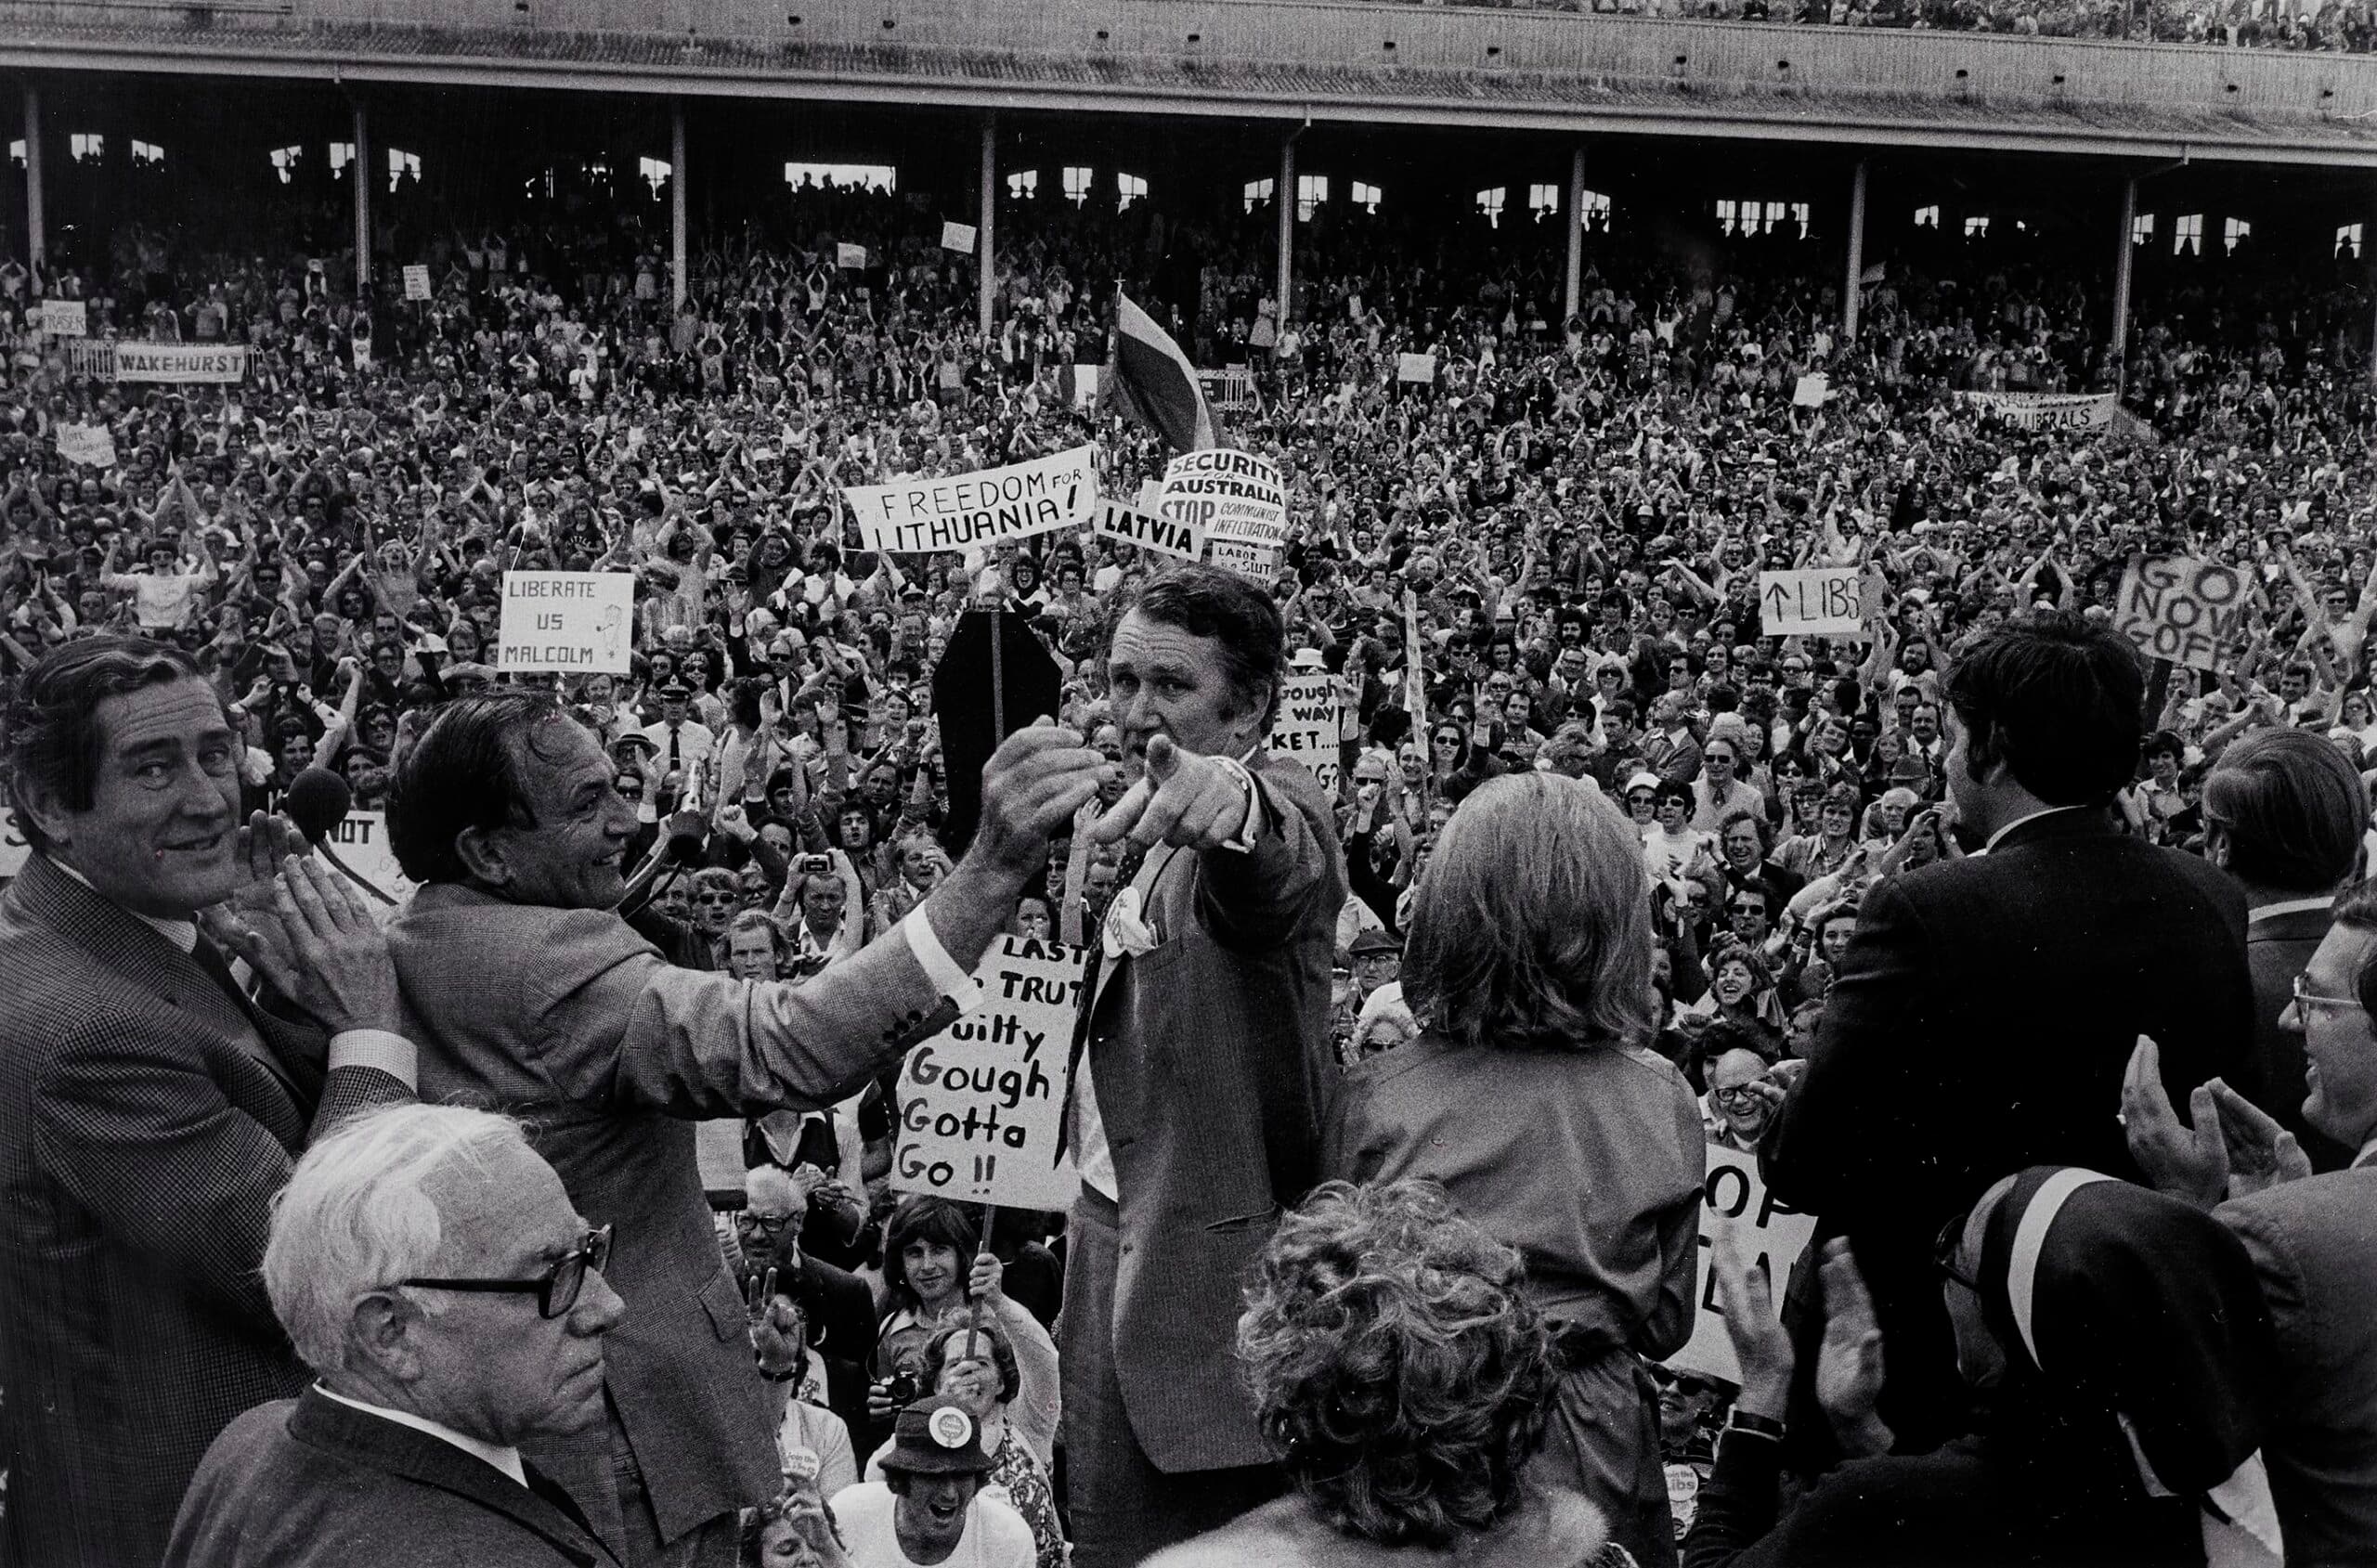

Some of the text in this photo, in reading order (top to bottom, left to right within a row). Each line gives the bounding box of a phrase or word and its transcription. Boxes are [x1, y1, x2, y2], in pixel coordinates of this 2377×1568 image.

[119, 355, 241, 372] WAKEHURST
[1172, 453, 1279, 486] SECURITY
[881, 468, 1082, 521] FREEDOM FOR
[1164, 479, 1283, 507] AUSTRALIA
[1161, 500, 1215, 526] STOP
[1220, 502, 1280, 522] COMMUNIST
[1104, 507, 1193, 553] LATVIA
[1218, 546, 1257, 561] LABOR
[1241, 561, 1271, 575] SLUT
[2137, 555, 2240, 604] GO
[509, 580, 596, 598] LIBERATE
[1799, 577, 1860, 620] LIBS
[537, 614, 563, 630] US
[504, 646, 593, 664] MALCOLM
[1292, 705, 1335, 722] WAY
[1003, 937, 1088, 965] LAST
[952, 1015, 1046, 1063] uilty
[910, 1046, 1050, 1108] Gough
[903, 1097, 1026, 1148] Gotta
[898, 1144, 954, 1186] Go
